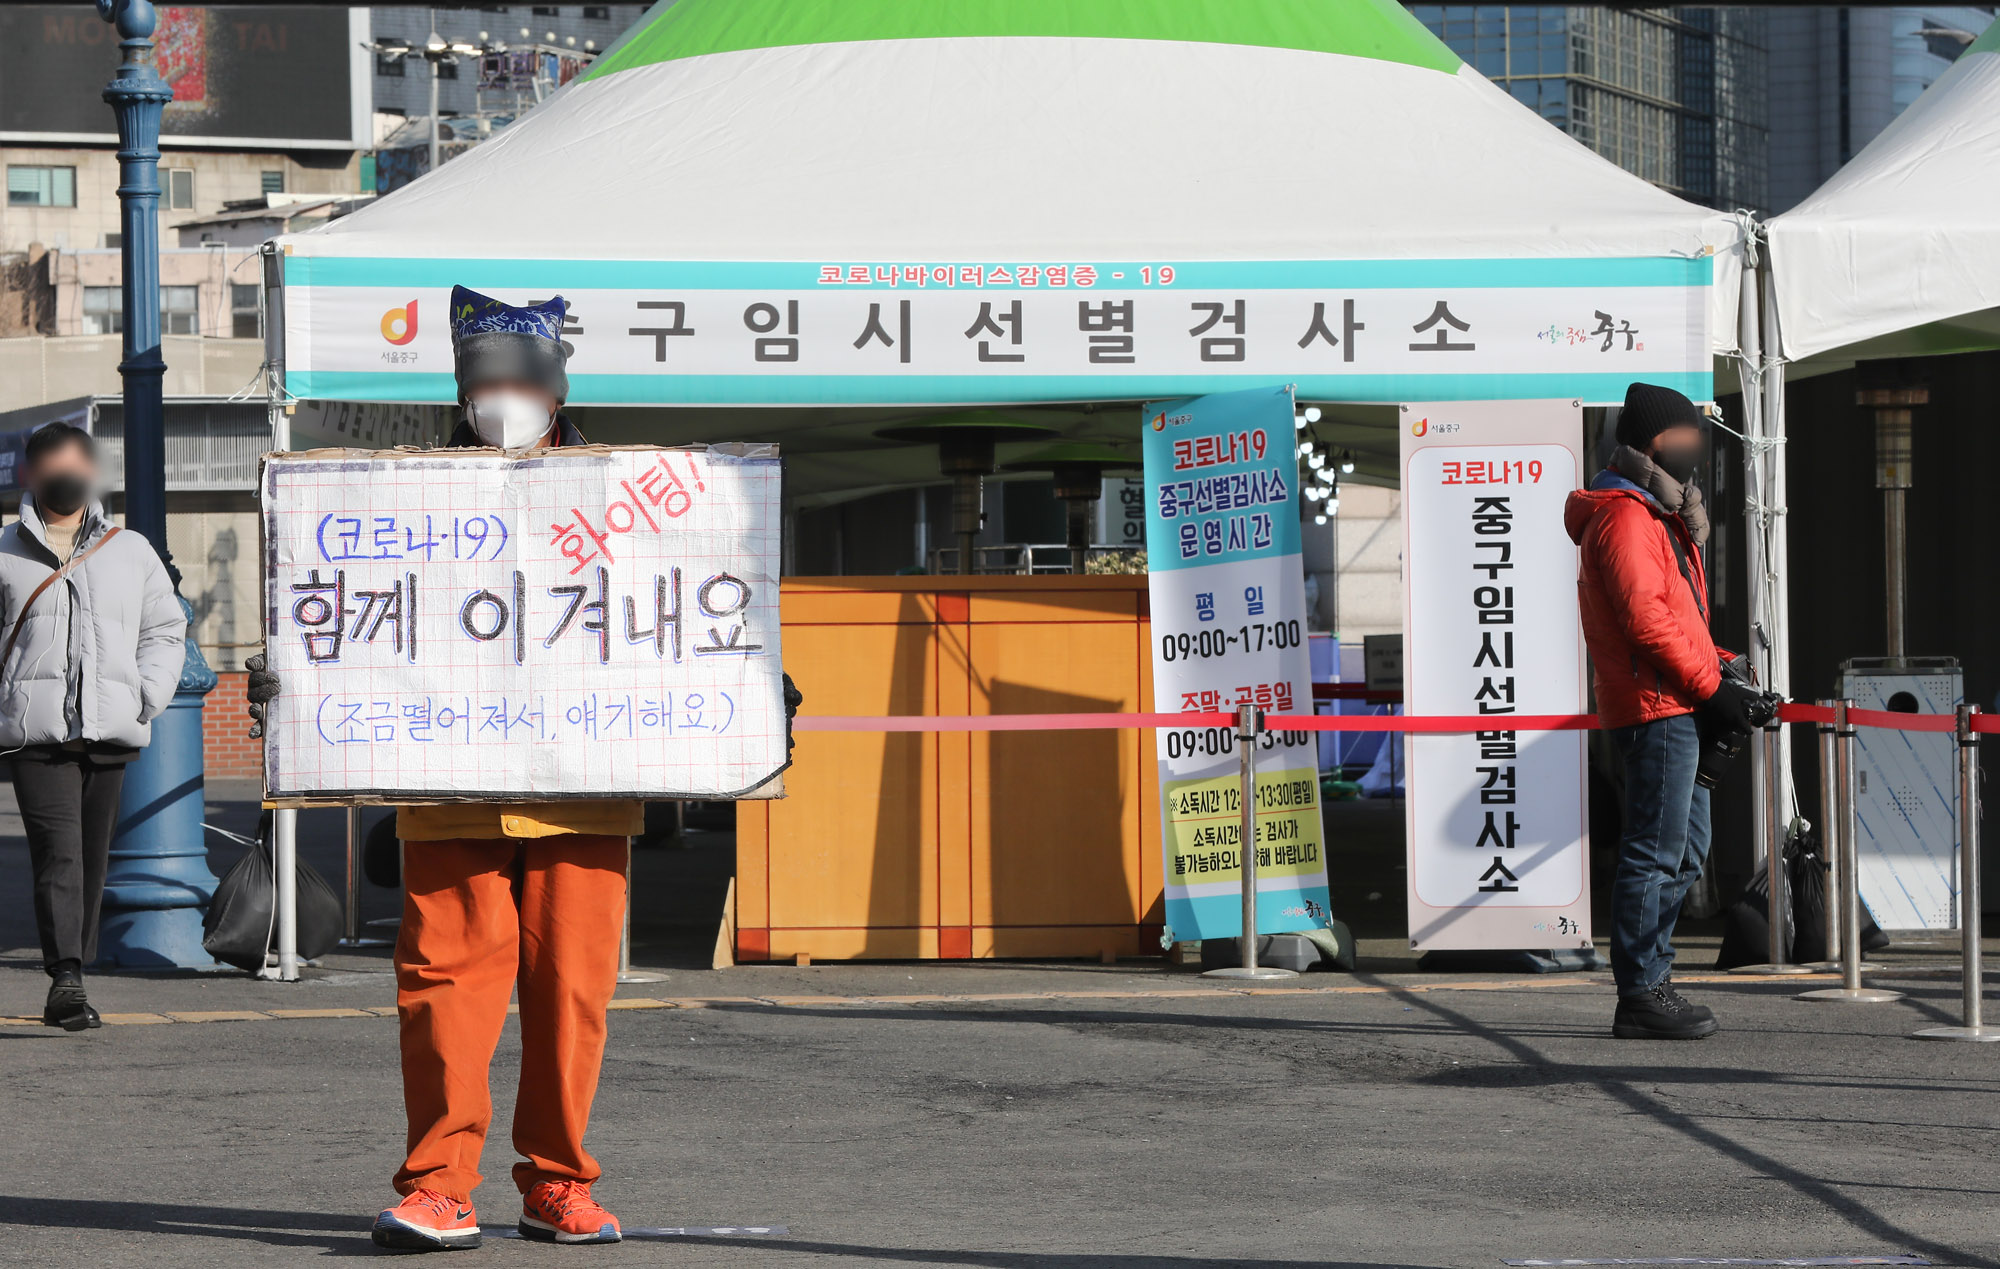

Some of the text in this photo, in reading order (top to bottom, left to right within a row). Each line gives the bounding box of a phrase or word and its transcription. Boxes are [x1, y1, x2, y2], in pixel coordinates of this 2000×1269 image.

[234, 22, 288, 51] TAI
[818, 265, 1099, 287] 코로나바이러스감염증
[1138, 266, 1177, 285] 19
[527, 299, 1477, 364] 구임시선별검사소
[1590, 309, 1640, 353] 중구
[380, 351, 419, 364] 서울중구
[1168, 414, 1193, 426] 서울중구
[1431, 423, 1461, 433] 서울중구
[1173, 430, 1268, 471] 코로나19
[1441, 460, 1543, 485] 코로나19
[1158, 469, 1288, 519] 중구선별검사소
[551, 451, 706, 576] 화이팅!
[290, 567, 418, 664] 함께
[1162, 619, 1301, 662] 09:00~17:00
[1265, 819, 1299, 842] 검사가
[1275, 843, 1318, 866] 바랍니다
